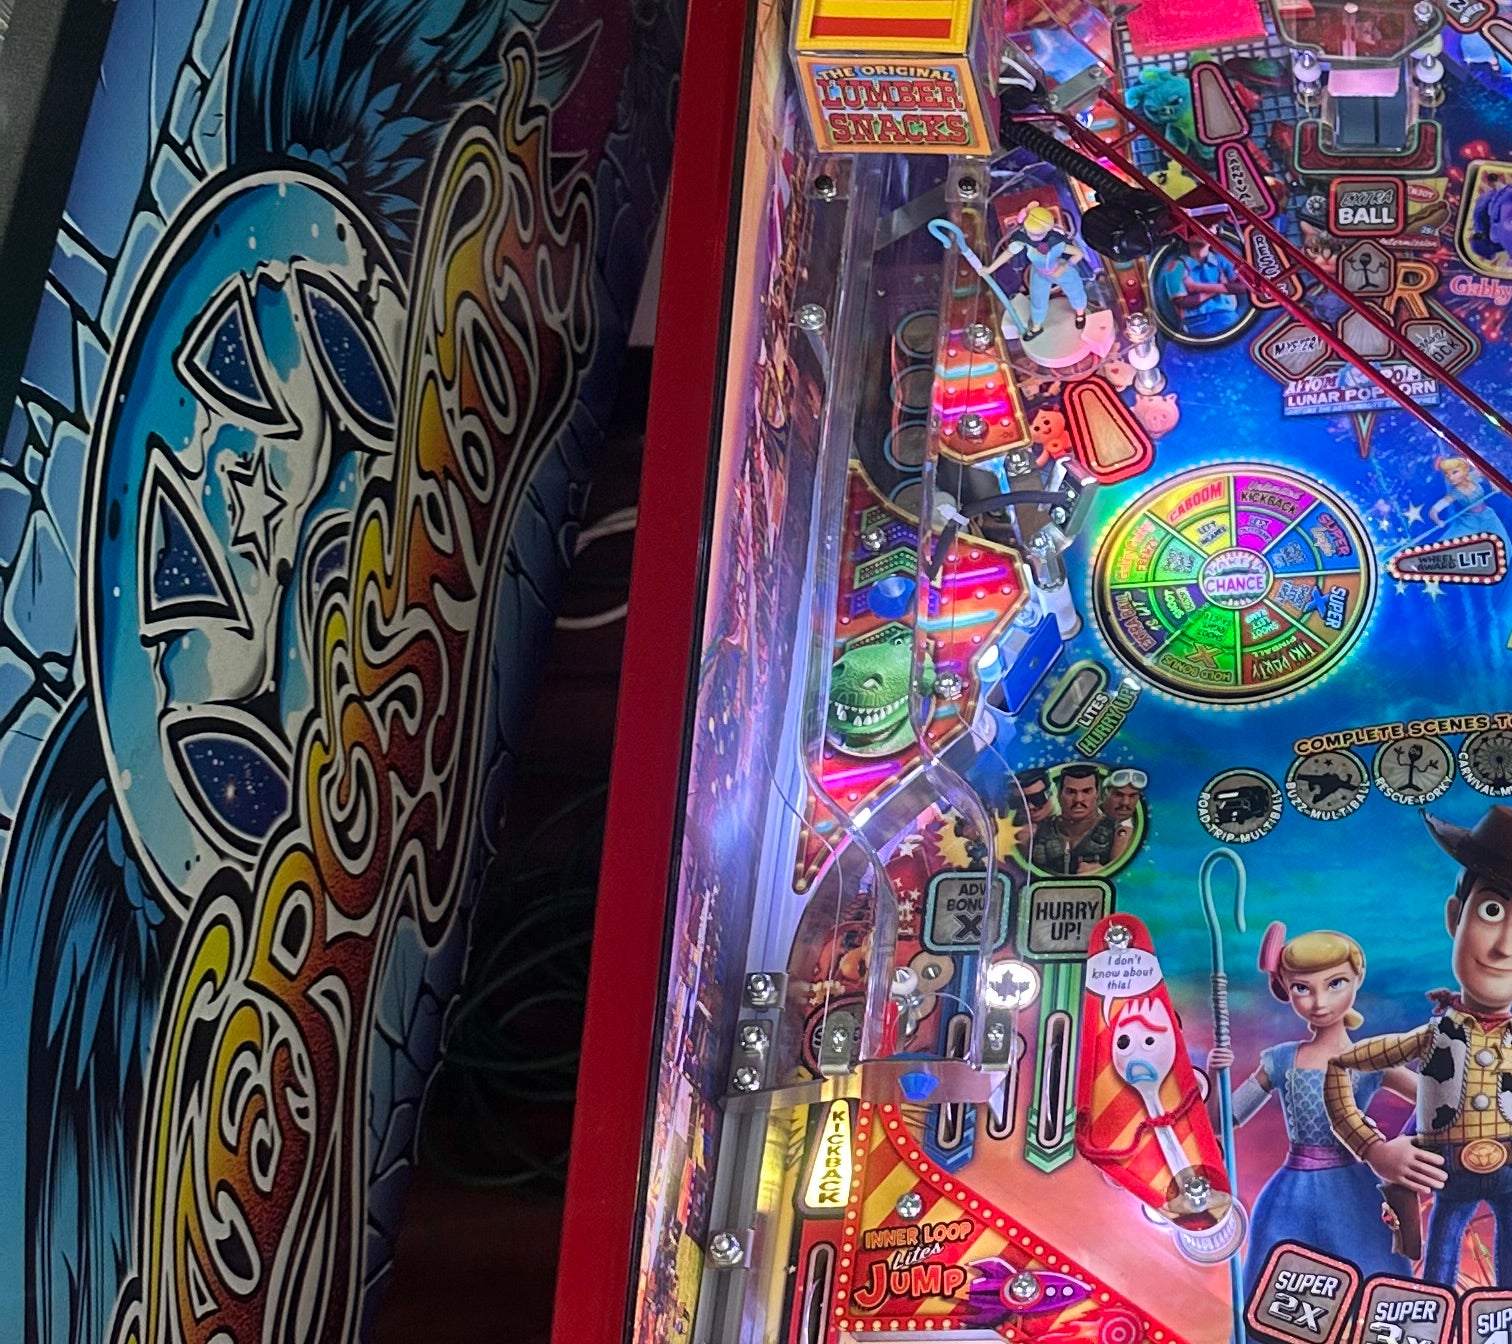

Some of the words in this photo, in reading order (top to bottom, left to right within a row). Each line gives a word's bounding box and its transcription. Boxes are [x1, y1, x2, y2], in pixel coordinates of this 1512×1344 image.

[816, 66, 856, 82] THE
[860, 64, 955, 83] ORIGINAL
[814, 79, 968, 112] LUMBER
[825, 112, 971, 146] SNACKS
[1340, 188, 1394, 207] EXTRA
[1338, 206, 1395, 225] BALL
[1344, 378, 1437, 402] POPORN
[1168, 479, 1226, 524] CABOOM
[1240, 492, 1298, 514] KICKBACK
[1317, 513, 1352, 558] SUPER
[1458, 550, 1492, 567] LIT
[1204, 576, 1265, 594] CHANCE
[1325, 585, 1350, 629] SUPER
[1076, 704, 1124, 757] HURRY
[1116, 677, 1143, 716] UP!
[1078, 692, 1109, 728] LITES
[1293, 721, 1403, 754] COMPLETE
[1405, 714, 1492, 739] SCENES
[1035, 901, 1099, 921] HURRY
[1051, 921, 1082, 942] UP!
[1114, 954, 1142, 966] don't
[1092, 968, 1121, 980] know
[1122, 967, 1154, 979] about
[1107, 978, 1132, 991] this!
[818, 1109, 845, 1204] KICKBACK
[863, 1227, 919, 1250] INNER
[923, 1220, 974, 1243] LOOP
[890, 1242, 945, 1271] Lites
[852, 1262, 967, 1308] JUMP
[1274, 1270, 1341, 1299] SUPER
[1374, 1300, 1438, 1324] SUPER
